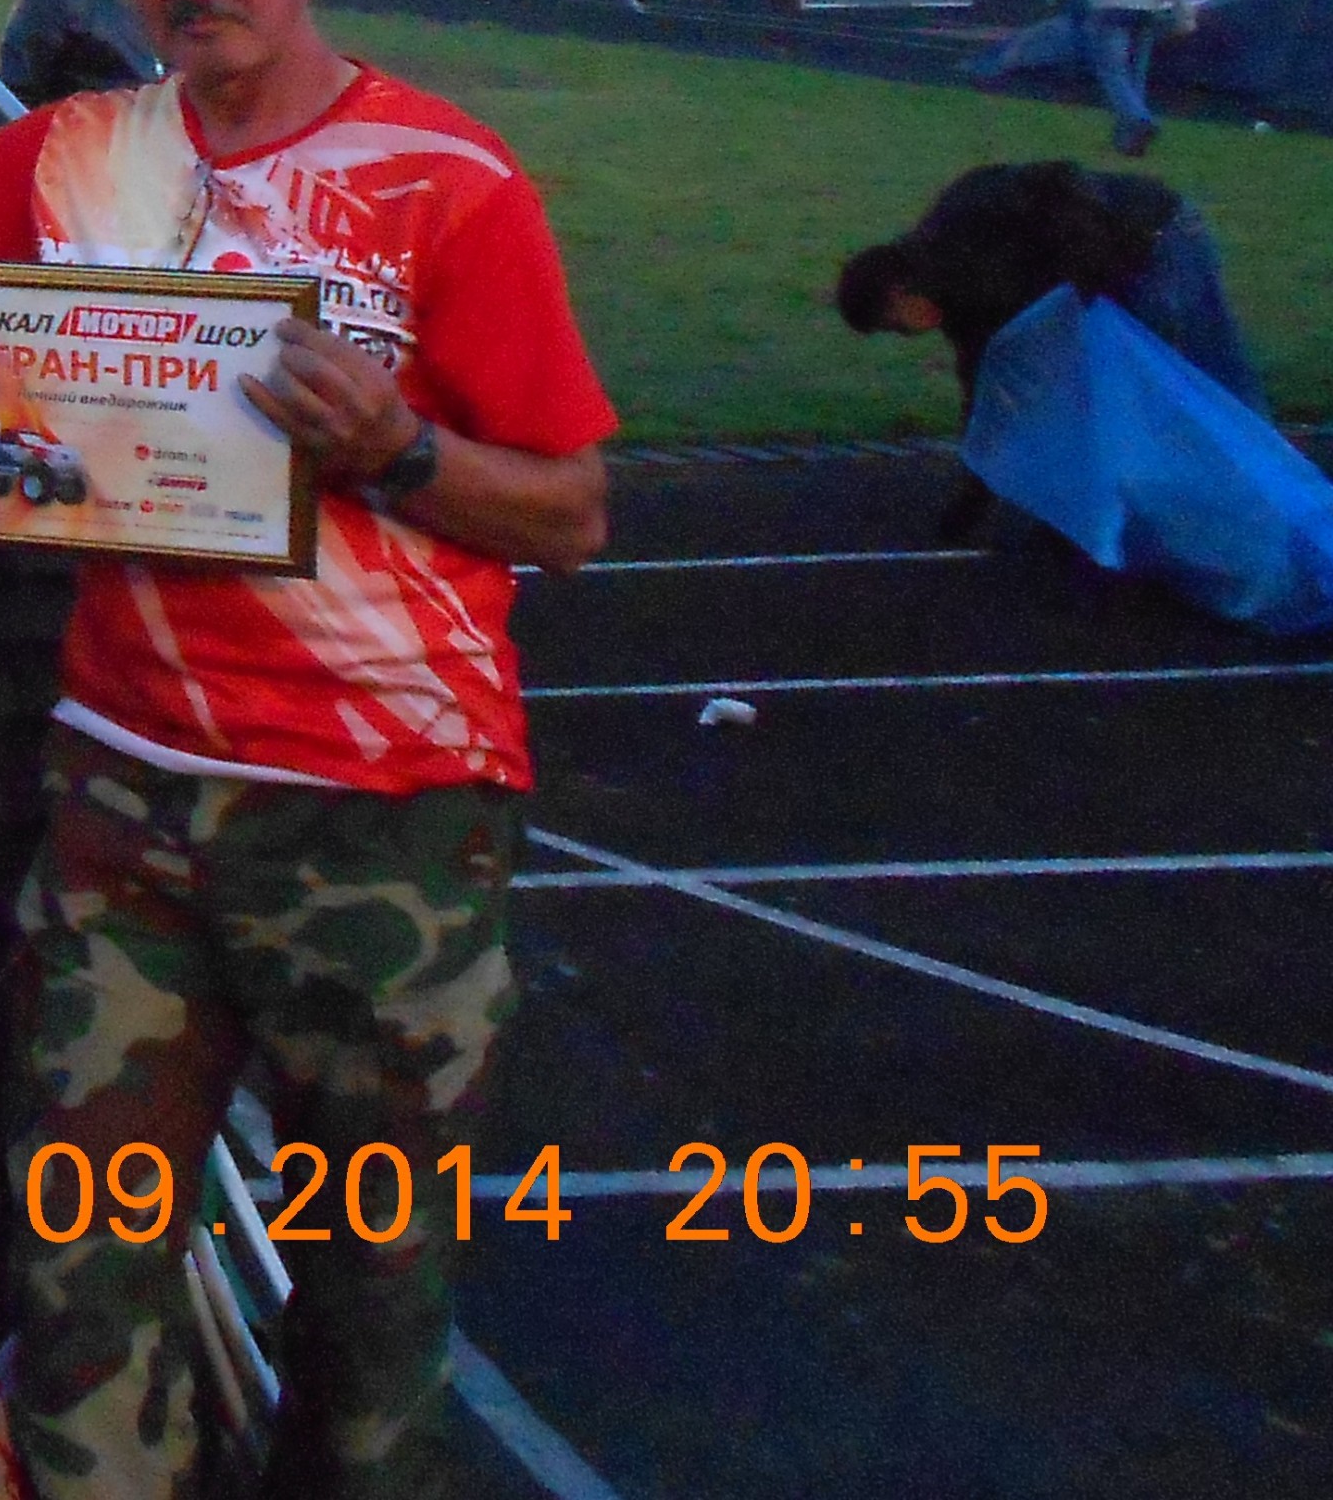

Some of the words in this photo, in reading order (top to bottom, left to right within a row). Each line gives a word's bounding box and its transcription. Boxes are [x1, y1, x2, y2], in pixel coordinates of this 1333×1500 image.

[323, 278, 401, 318] m.ru
[76, 309, 179, 340] МОТОР
[193, 325, 269, 349] ШОУ
